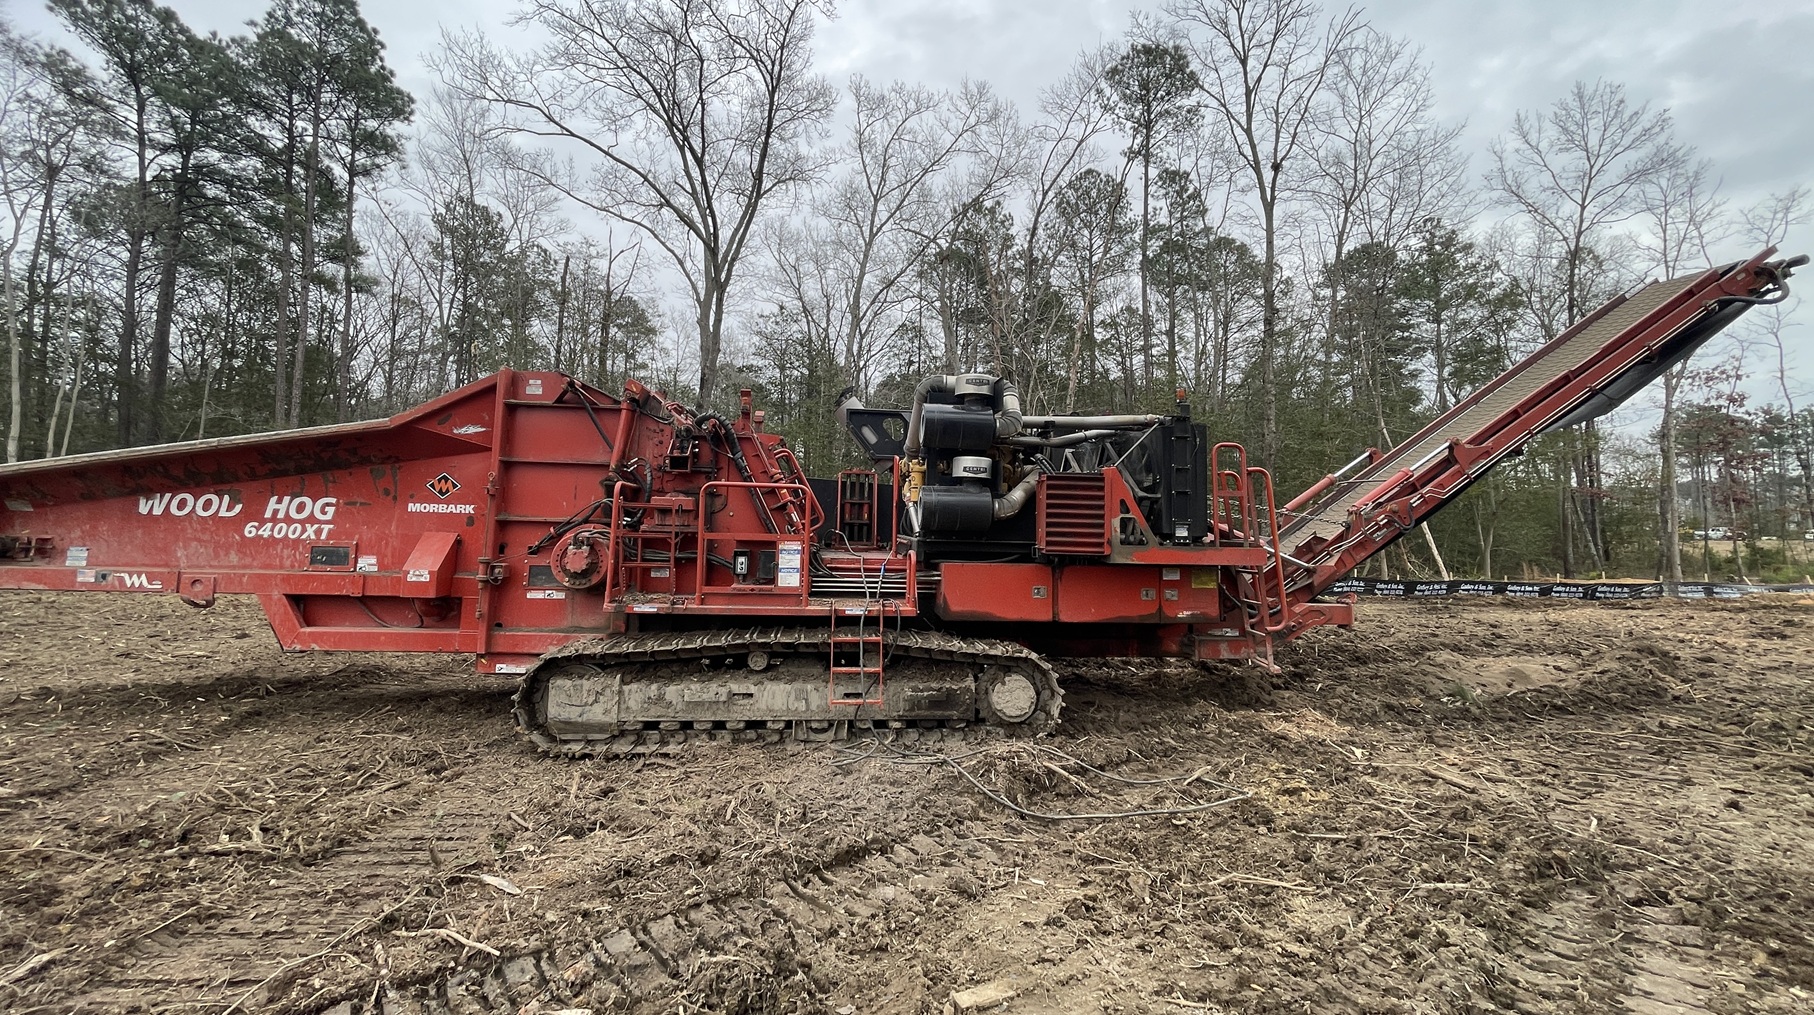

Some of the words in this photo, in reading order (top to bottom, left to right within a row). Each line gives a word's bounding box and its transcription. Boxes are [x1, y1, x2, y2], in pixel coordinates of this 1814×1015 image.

[138, 493, 243, 517] WOOD
[264, 495, 337, 520] HOG
[407, 502, 475, 514] MORBARK
[243, 521, 335, 540] 6400XT
